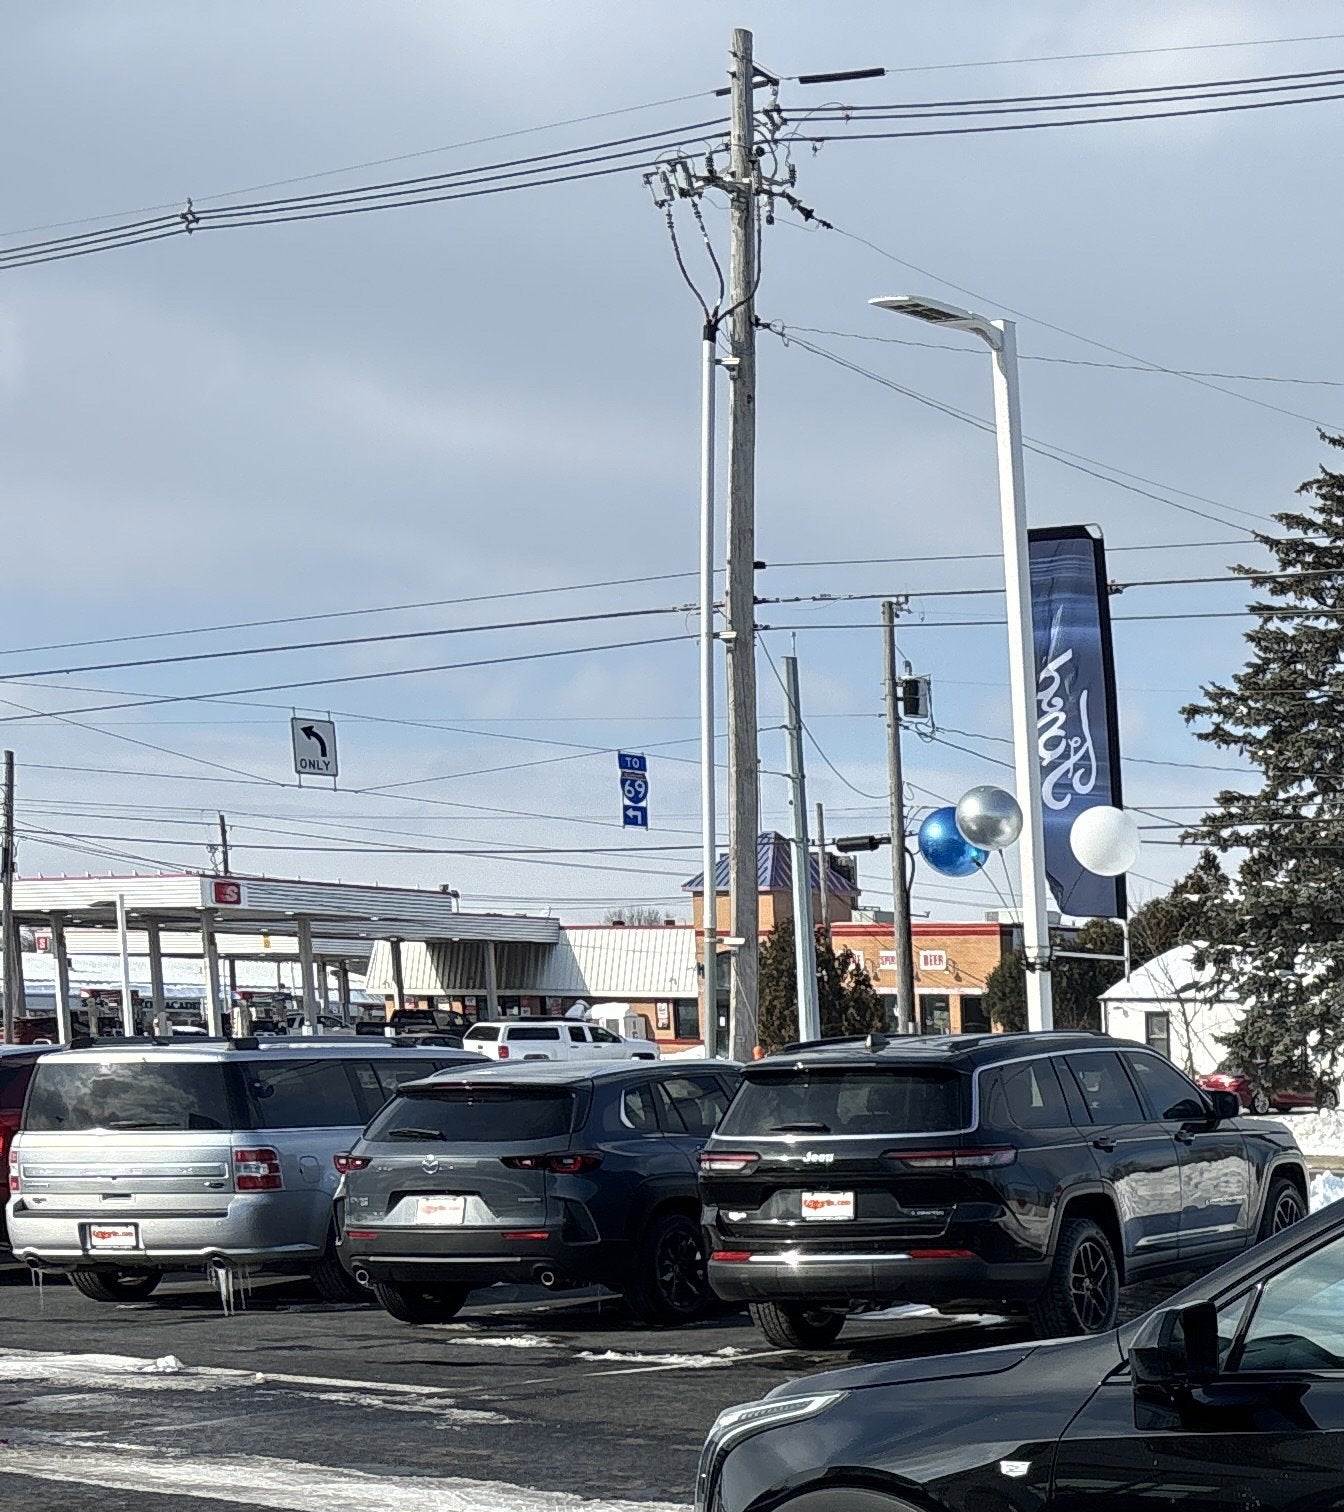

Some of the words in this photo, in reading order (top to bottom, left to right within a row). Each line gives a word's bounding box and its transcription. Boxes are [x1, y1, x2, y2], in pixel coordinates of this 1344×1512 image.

[299, 758, 331, 771] ONLY
[625, 757, 640, 769] TO
[624, 780, 646, 799] 69
[923, 954, 944, 966] BEER
[801, 1151, 835, 1164] Jeep
